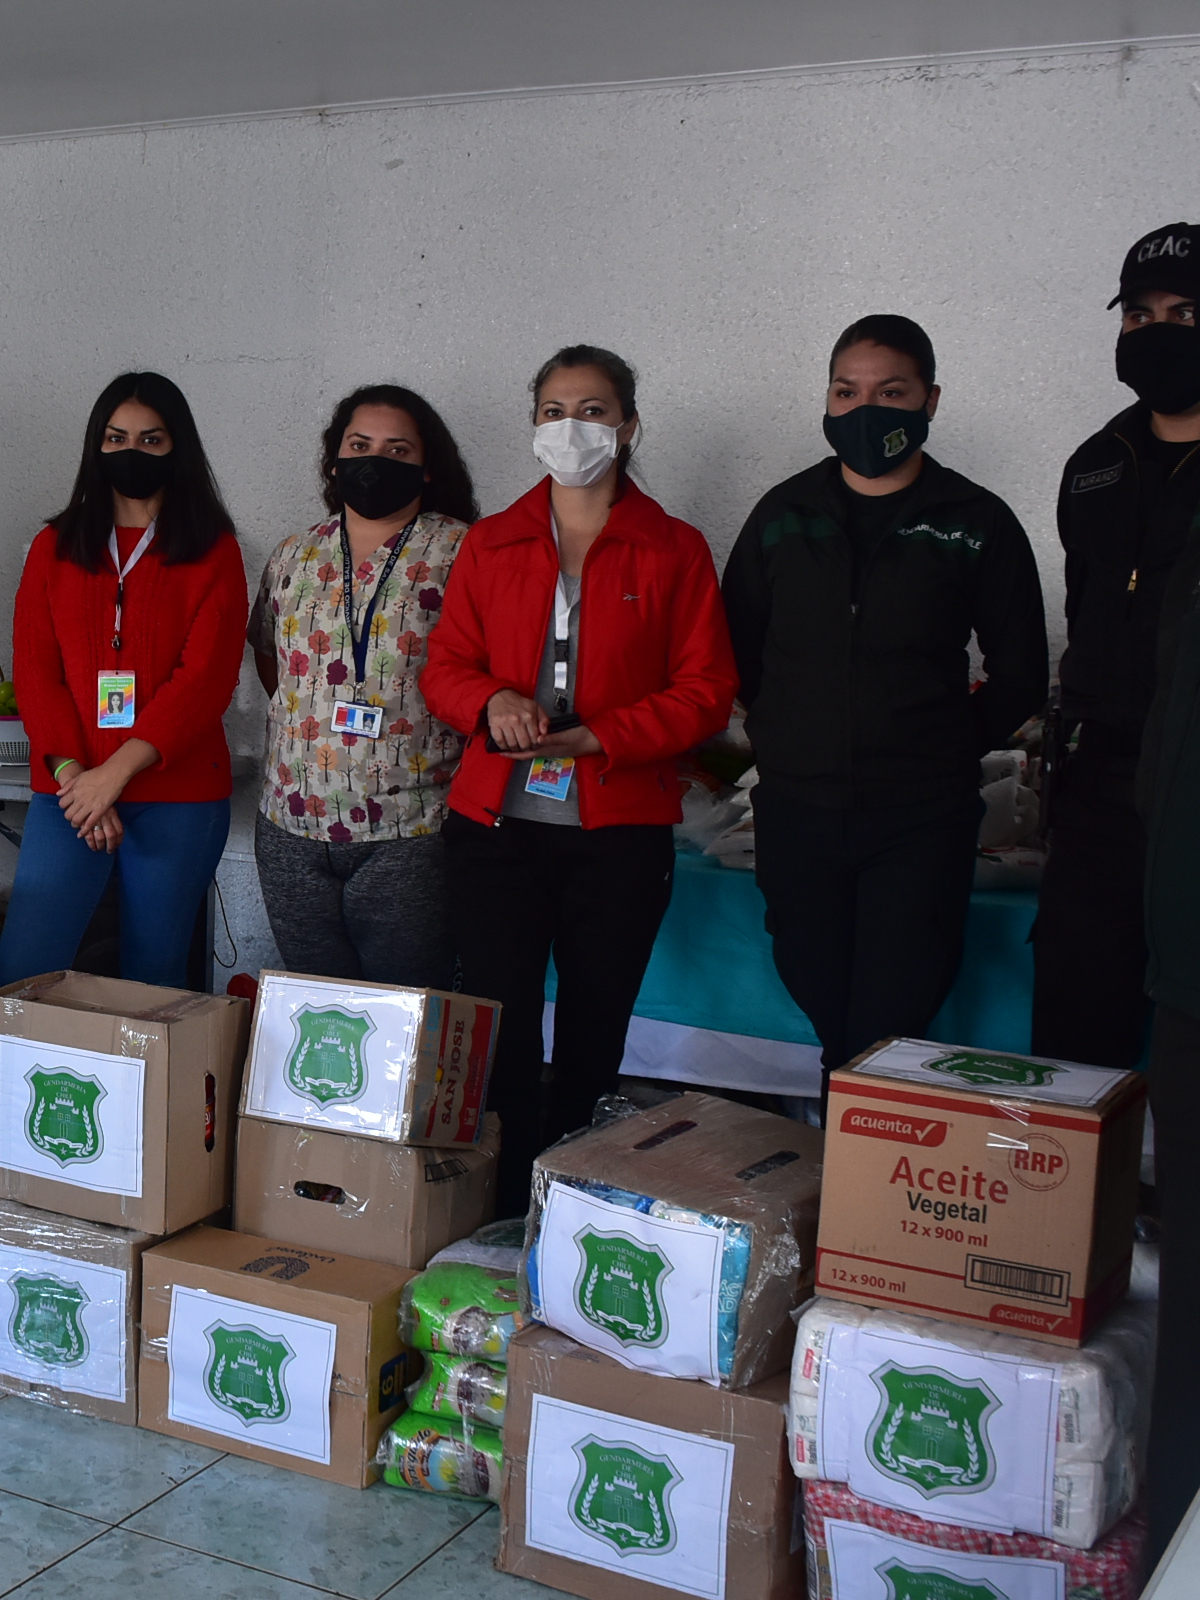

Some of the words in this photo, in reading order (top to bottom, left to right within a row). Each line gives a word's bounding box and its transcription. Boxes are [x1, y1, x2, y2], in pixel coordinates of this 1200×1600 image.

[1138, 236, 1191, 263] CEAC
[393, 524, 413, 554] SERVICIO
[950, 532, 963, 540] DE
[387, 554, 396, 568] DE
[344, 582, 350, 595] DE
[311, 1018, 356, 1031] GENDARMERIA
[442, 1080, 457, 1125] SAN
[451, 1020, 465, 1074] JOSE
[43, 1080, 87, 1094] GENDARMERIA
[56, 1092, 73, 1100] CHILE
[851, 1113, 912, 1135] acuenta
[1014, 1149, 1063, 1175] RRP
[889, 1156, 1009, 1204] Aceite
[907, 1190, 987, 1224] Vegetal
[900, 1220, 918, 1235] 12
[922, 1226, 931, 1237] x
[935, 1227, 964, 1242] 900
[968, 1233, 988, 1247] ml
[265, 1246, 336, 1264] Unilever
[596, 1244, 648, 1267] GENDARMERIA
[617, 1254, 628, 1263] DE
[612, 1260, 633, 1272] CHILE
[831, 1267, 846, 1281] 12
[850, 1273, 858, 1284] x
[861, 1274, 886, 1289] 900
[889, 1280, 906, 1293] ml
[997, 1308, 1045, 1326] acuenta
[225, 1335, 273, 1355] GENDARMERIA
[238, 1350, 258, 1358] CHILE
[903, 1381, 967, 1405] GENDARMERIA
[929, 1391, 940, 1399] DE
[922, 1397, 947, 1409] CHILE
[599, 1454, 655, 1477] GENDARMERIA
[621, 1464, 633, 1473] DE
[615, 1470, 637, 1481] CHILE
[1054, 1500, 1065, 1528] Harina
[906, 1577, 974, 1599] GENDARMERIA
[932, 1587, 944, 1595] DE
